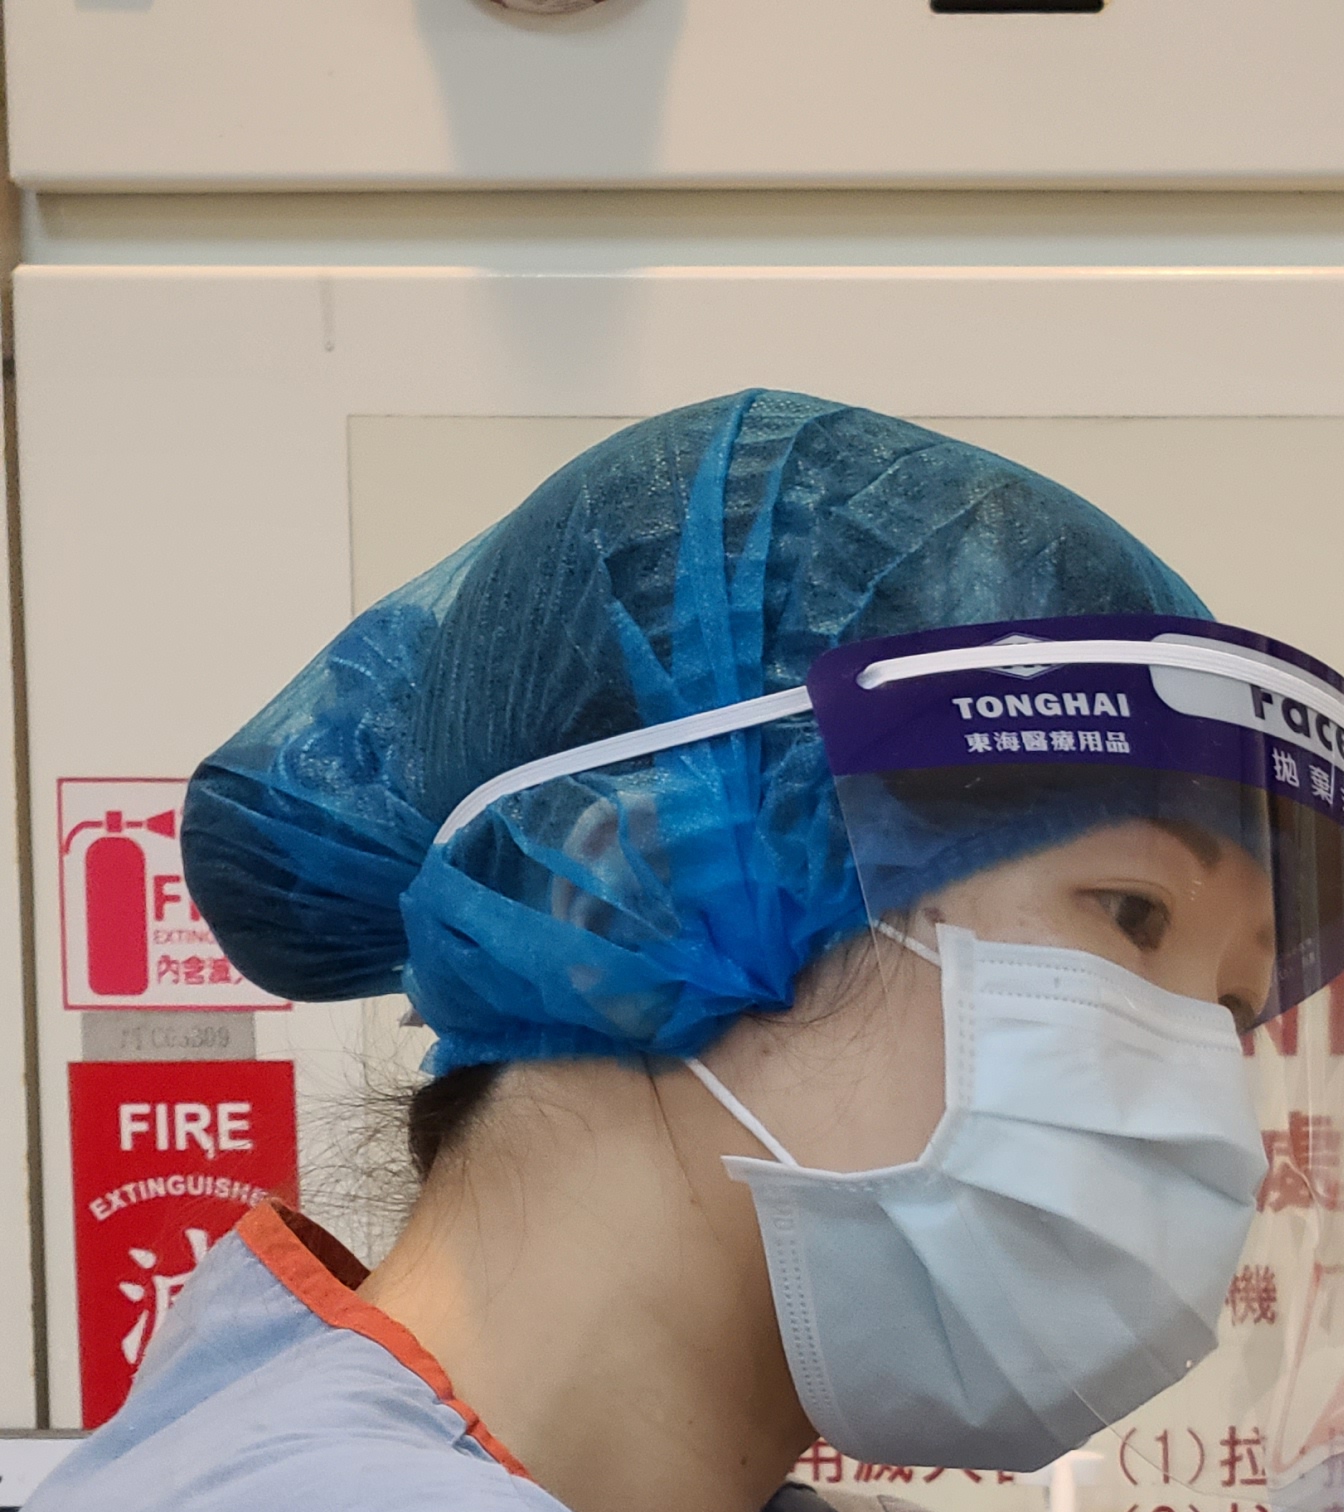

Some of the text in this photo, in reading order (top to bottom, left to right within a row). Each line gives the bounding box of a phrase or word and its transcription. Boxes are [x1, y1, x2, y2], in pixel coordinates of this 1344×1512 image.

[952, 692, 1131, 720] TONGHAI
[964, 729, 1131, 754] 東海醫療用品
[119, 1102, 254, 1159] FIRE
